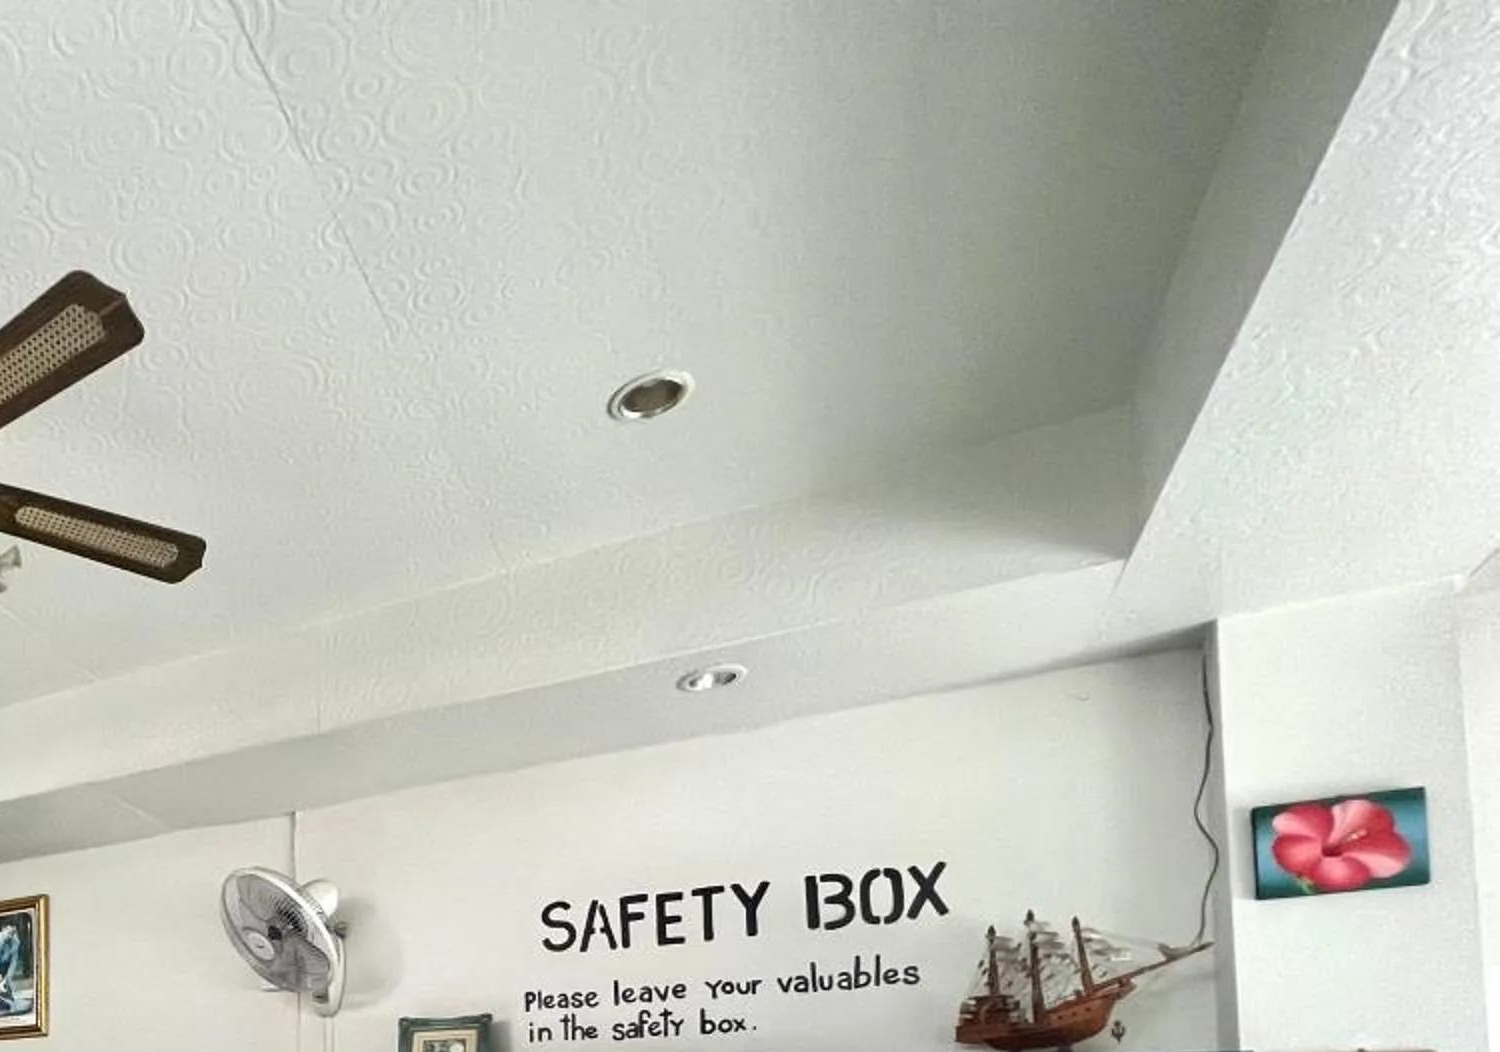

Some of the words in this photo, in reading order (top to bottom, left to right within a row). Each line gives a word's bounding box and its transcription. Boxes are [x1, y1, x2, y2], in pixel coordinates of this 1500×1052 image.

[540, 881, 771, 953] SAFETY
[804, 861, 950, 931] BOX
[524, 990, 600, 1013] Please
[613, 979, 688, 1006] leave
[777, 954, 921, 993] valuables
[529, 1021, 553, 1043] in
[560, 1013, 599, 1041] the
[611, 1008, 685, 1041] safety
